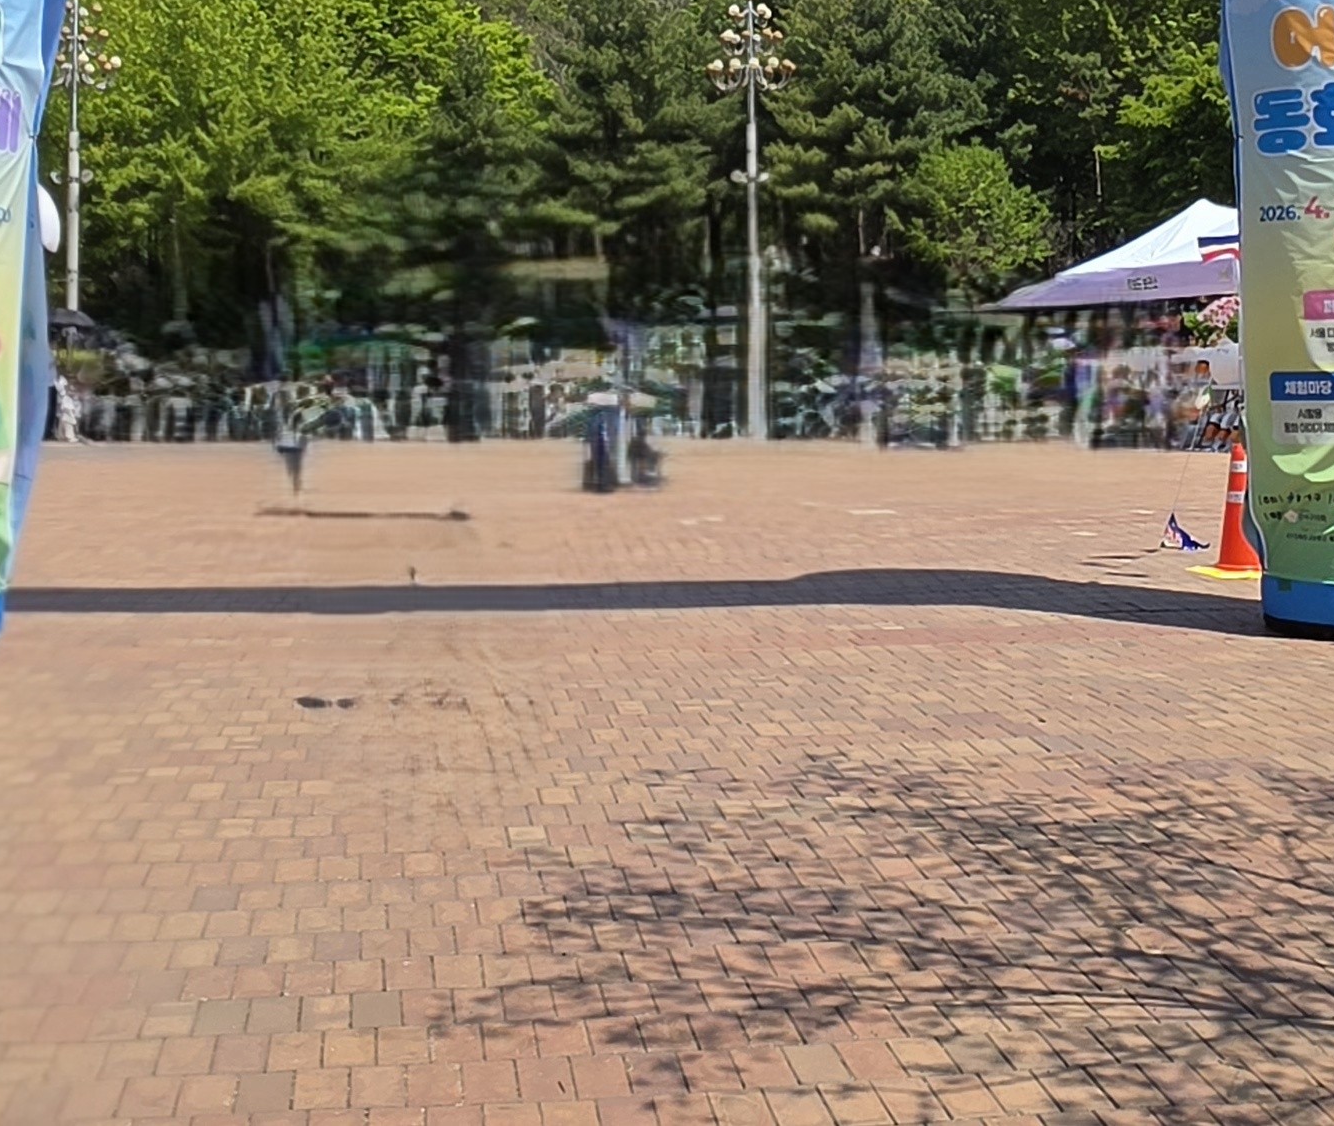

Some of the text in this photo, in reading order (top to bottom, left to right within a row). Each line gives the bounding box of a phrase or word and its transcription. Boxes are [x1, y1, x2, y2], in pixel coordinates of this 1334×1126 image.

[1259, 205, 1301, 222] 2026.
[1304, 195, 1330, 219] 4.
[1284, 380, 1333, 395] 체험마당
